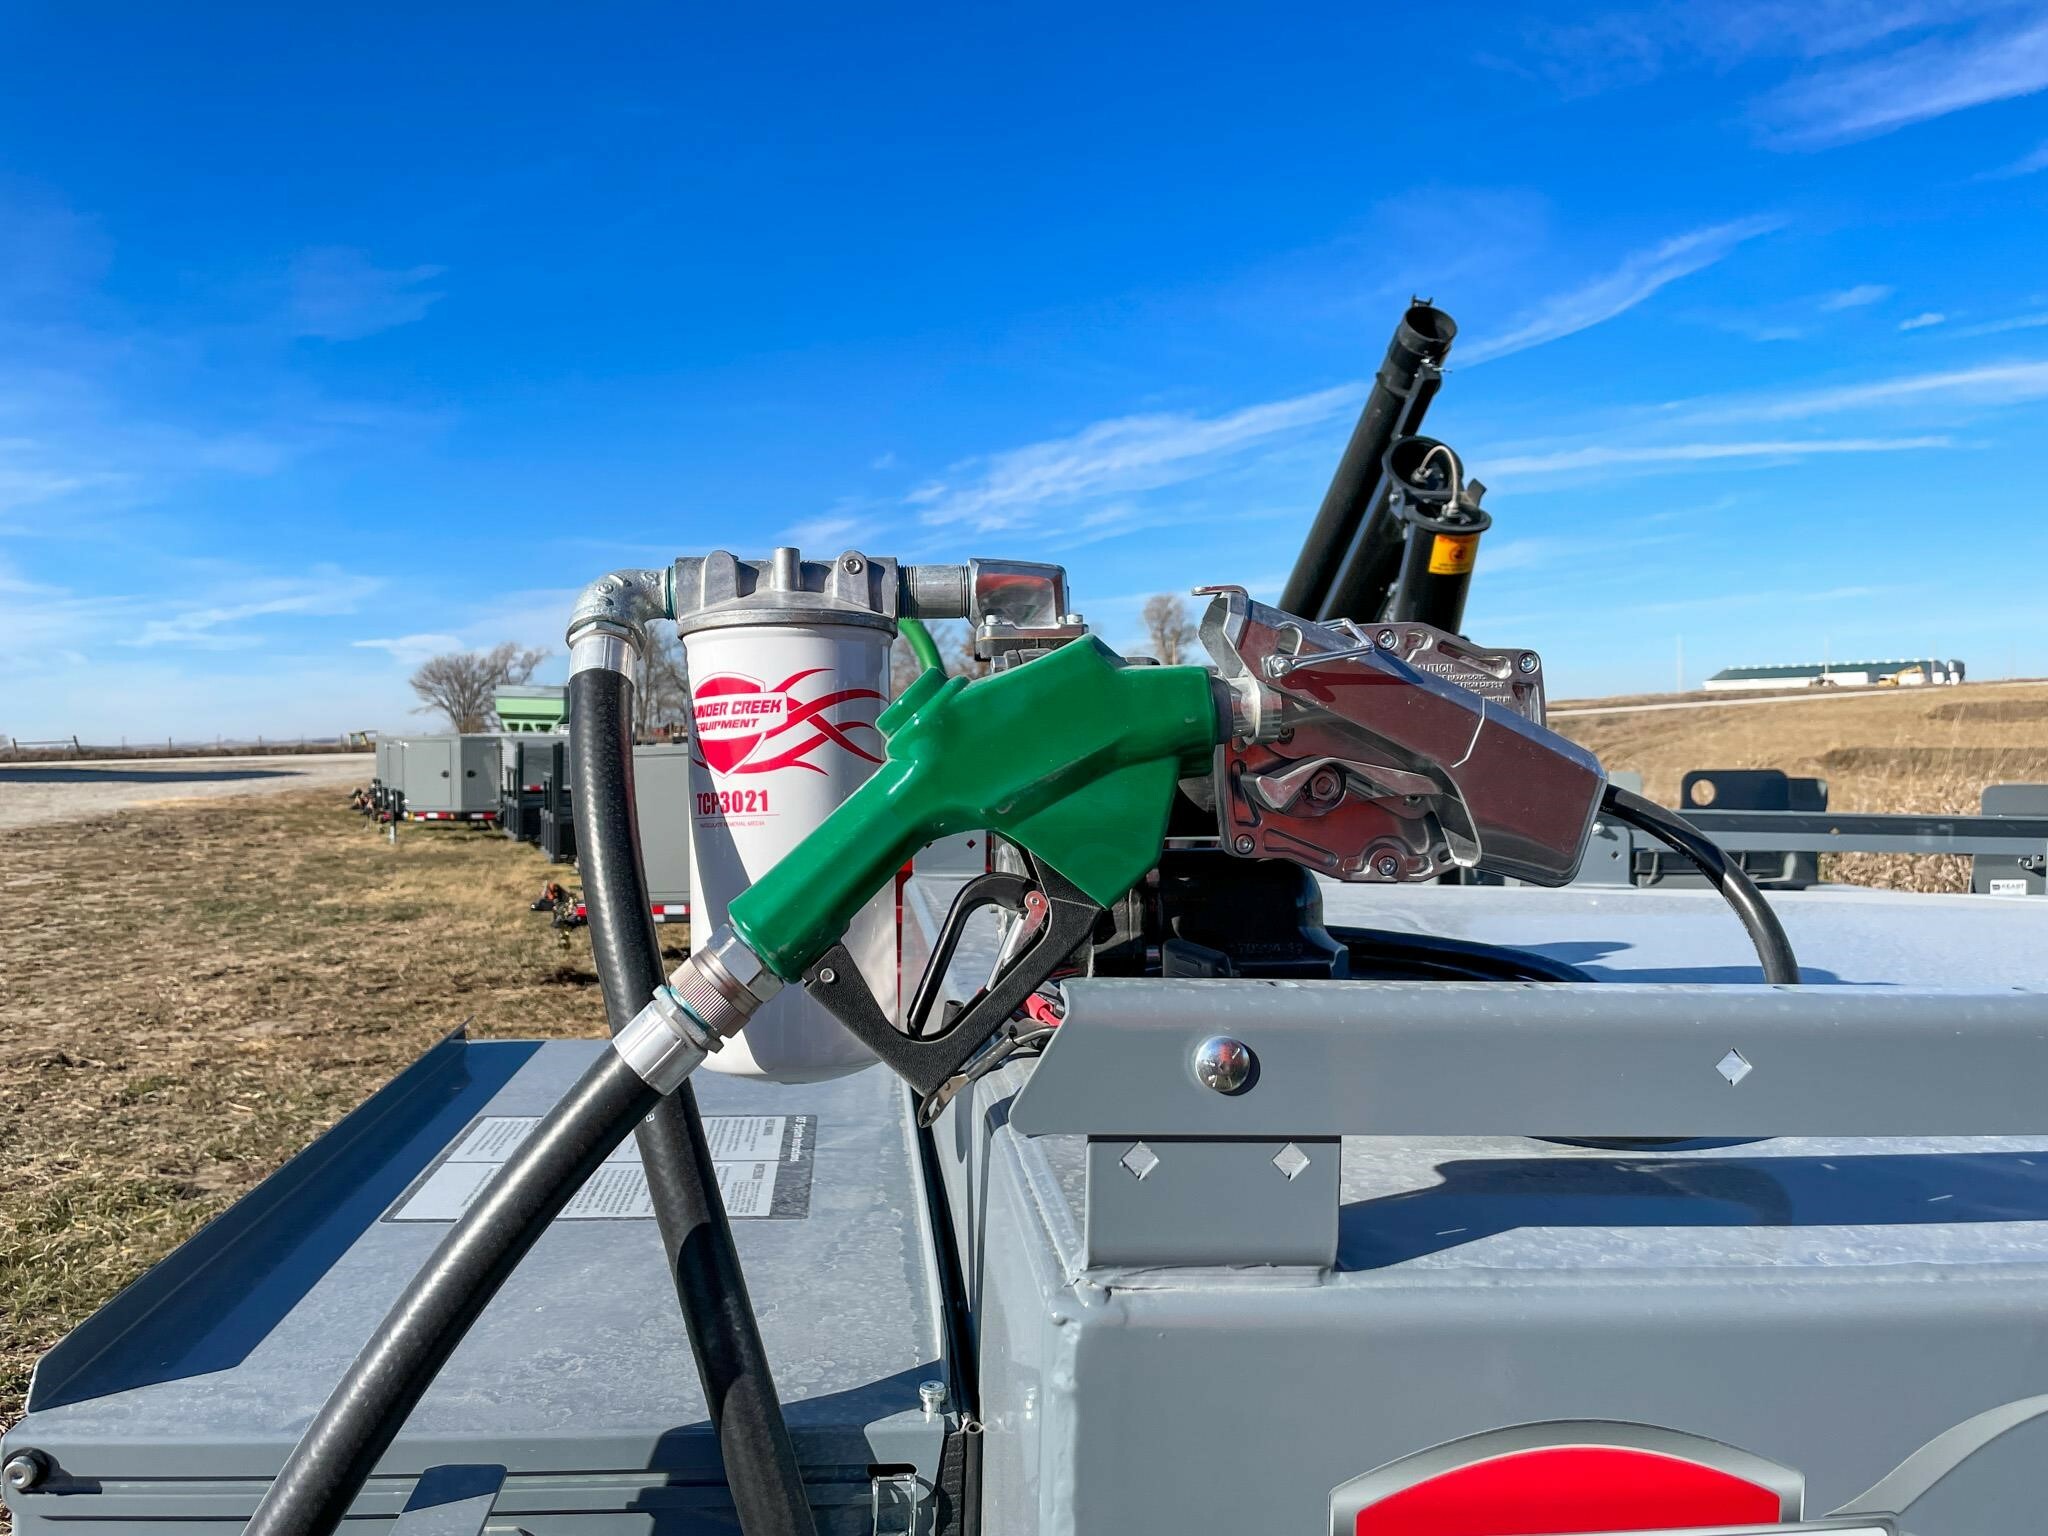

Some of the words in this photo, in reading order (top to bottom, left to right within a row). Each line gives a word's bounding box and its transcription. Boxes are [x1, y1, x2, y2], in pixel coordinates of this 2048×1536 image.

[1416, 664, 1455, 673] AUTION
[731, 699, 783, 715] CREEK
[696, 718, 759, 733] EQUIPMENT
[696, 789, 768, 815] TCP3021
